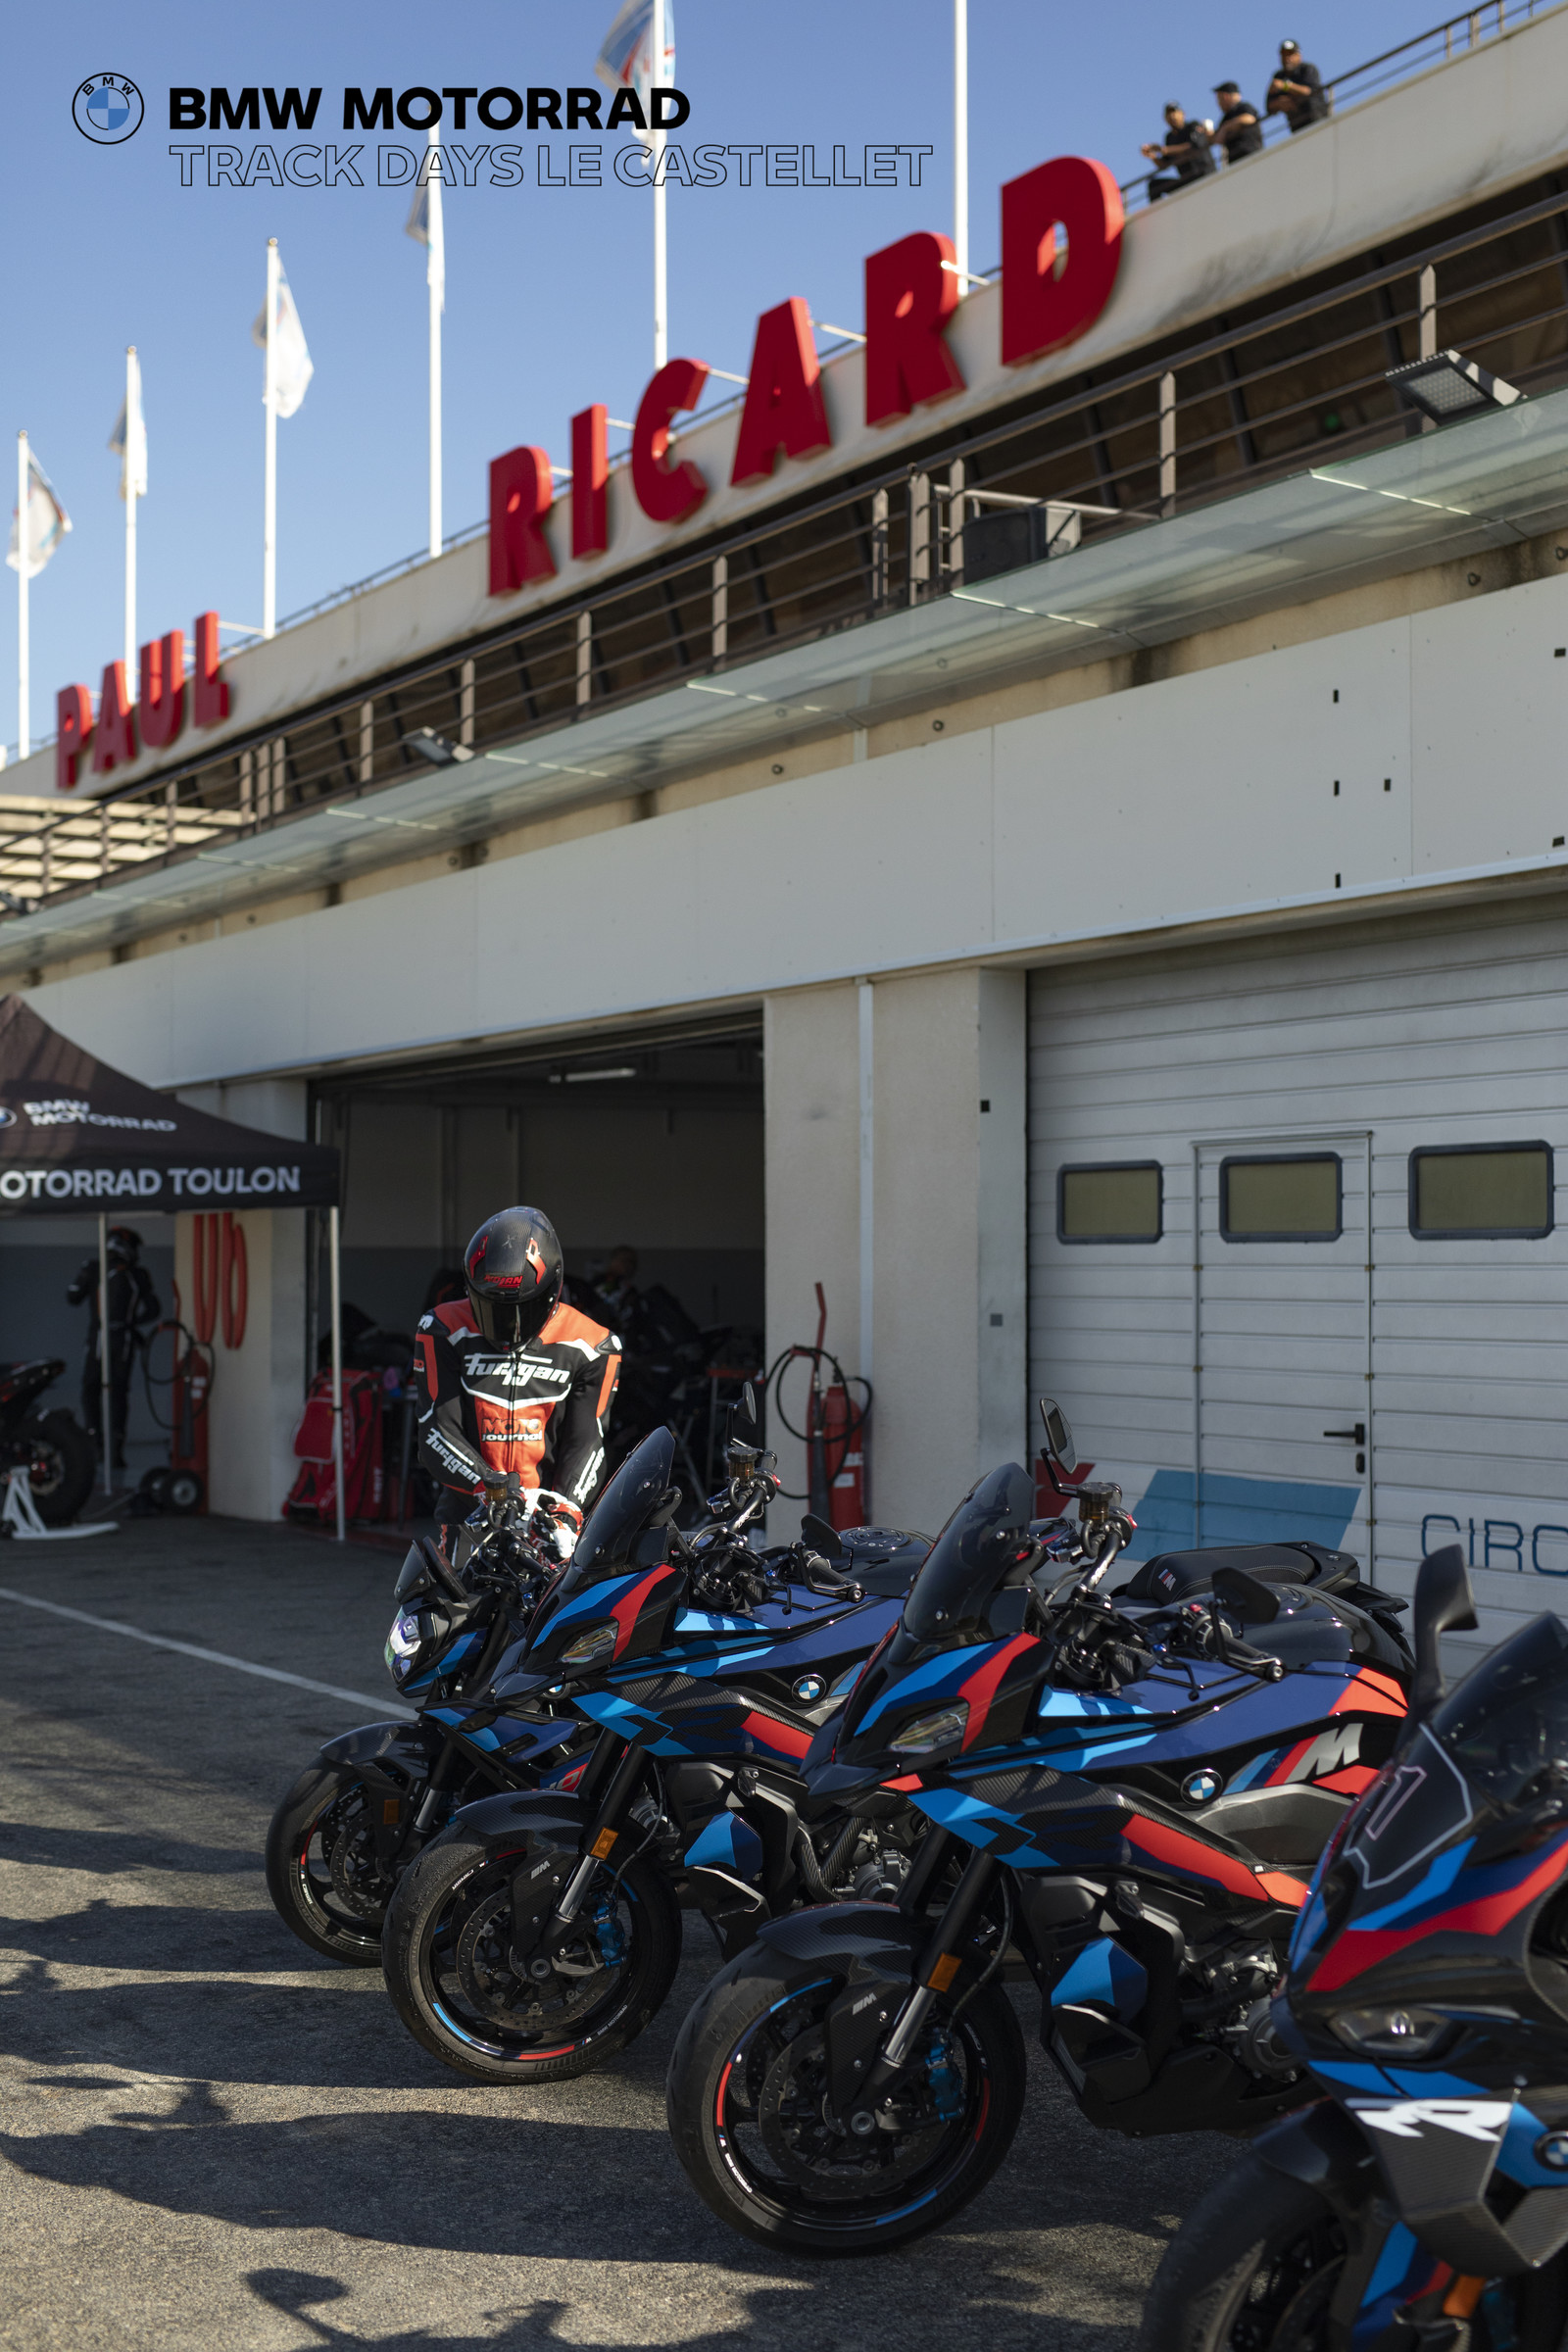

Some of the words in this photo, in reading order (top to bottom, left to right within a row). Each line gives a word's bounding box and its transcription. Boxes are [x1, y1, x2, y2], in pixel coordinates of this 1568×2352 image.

[56, 610, 230, 789] PAUL
[488, 156, 1125, 599] RICARD
[23, 1099, 90, 1116] BMW
[30, 1110, 177, 1132] MOTORRAD
[167, 1166, 300, 1196] TOULON
